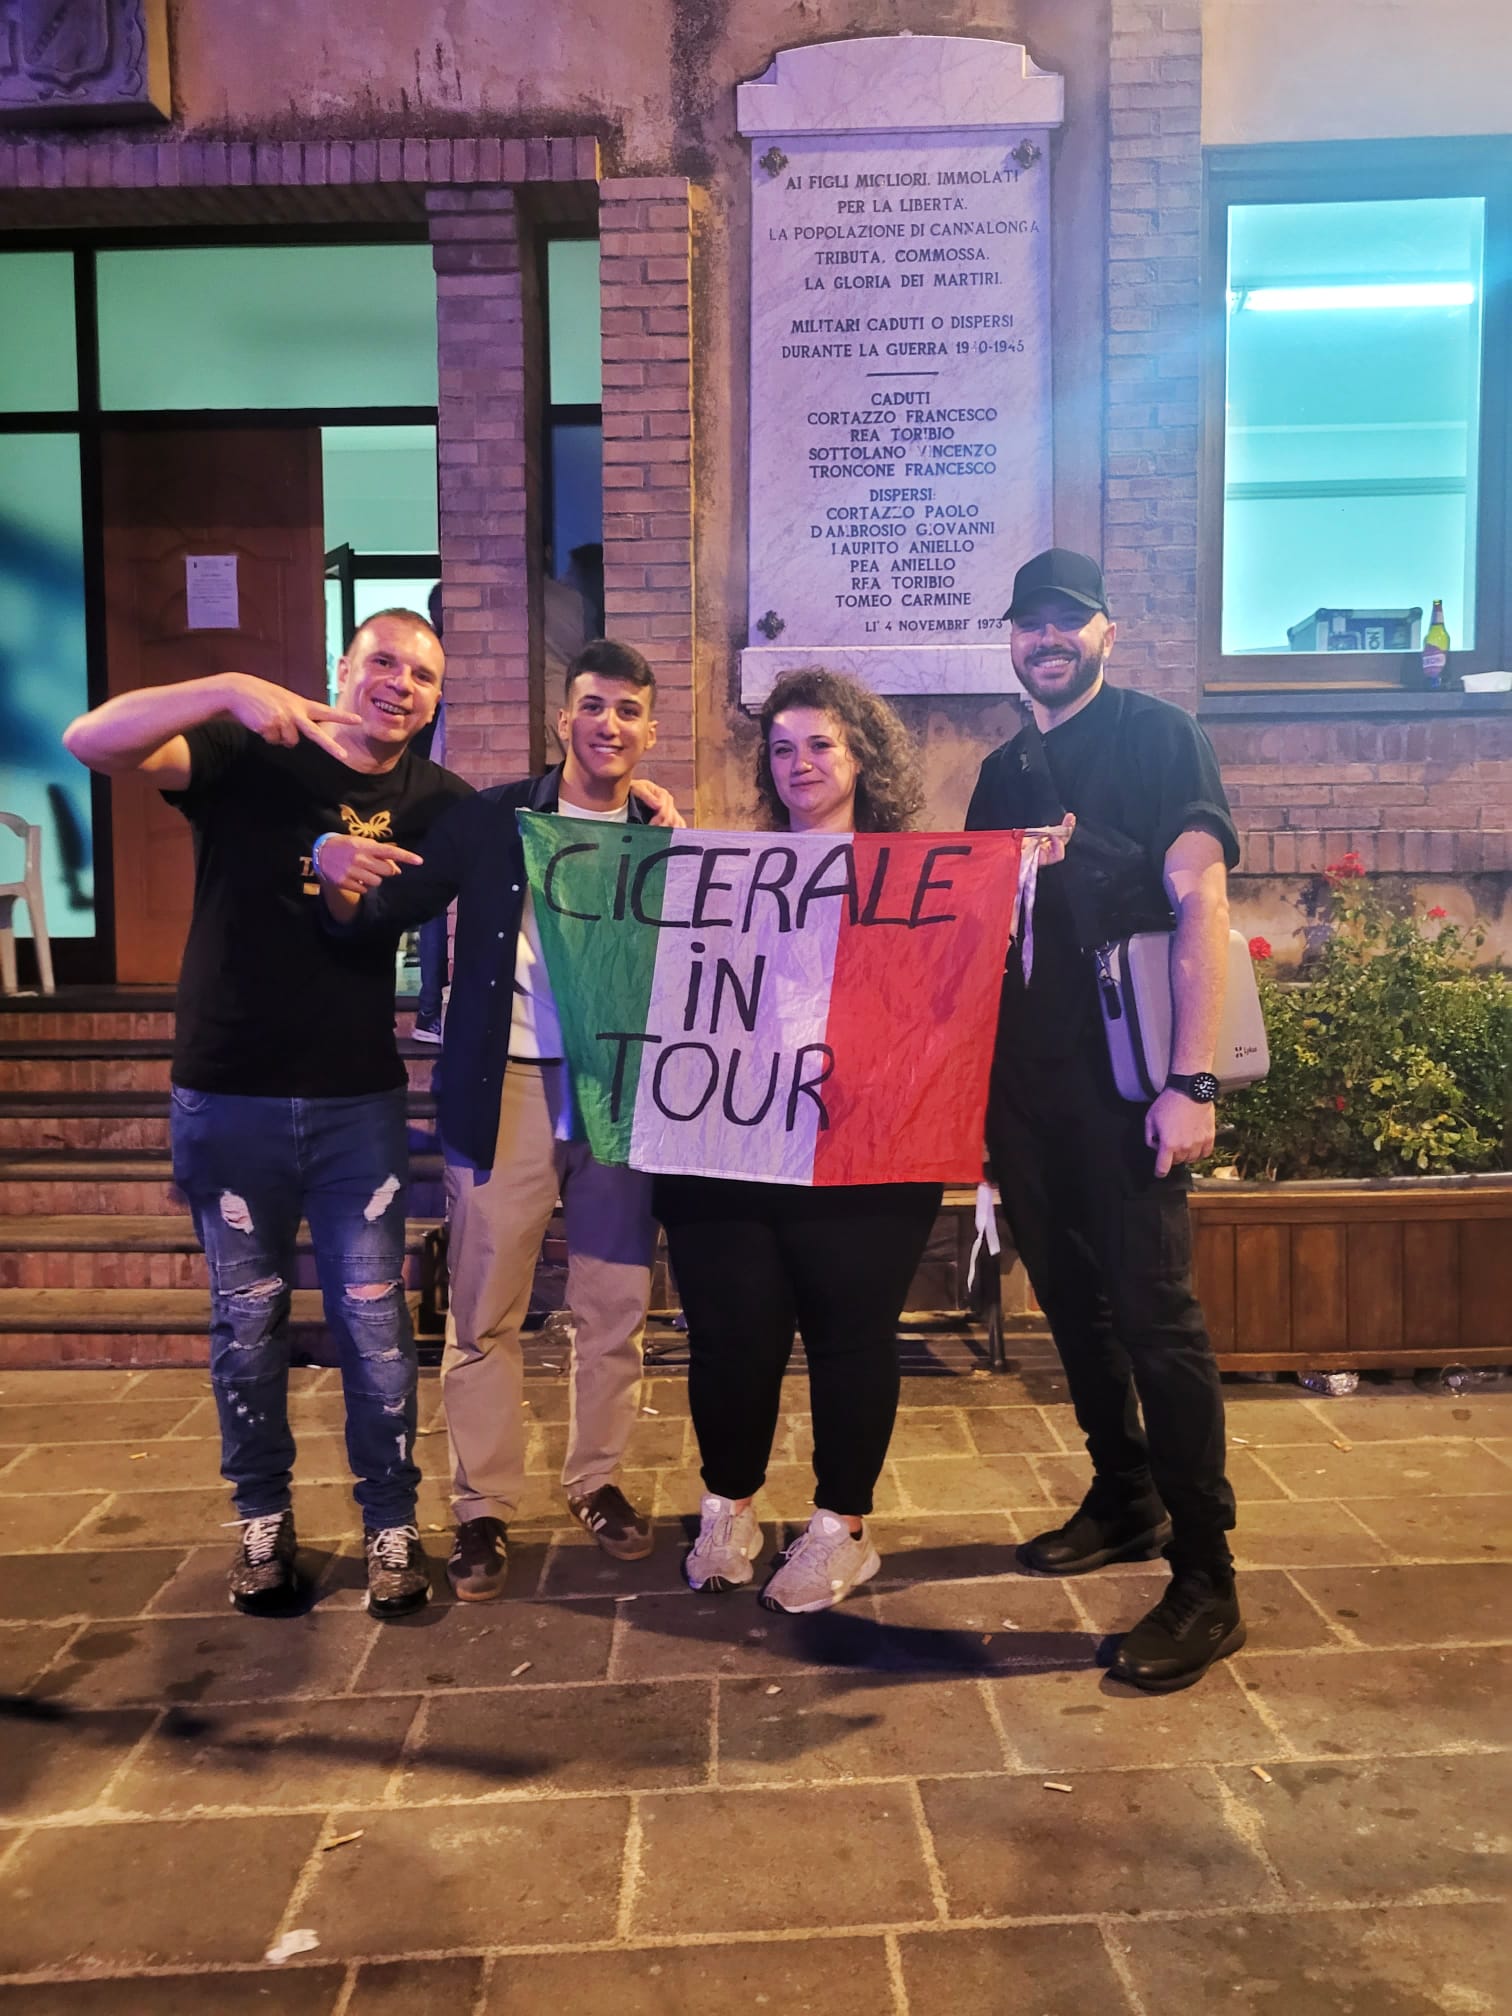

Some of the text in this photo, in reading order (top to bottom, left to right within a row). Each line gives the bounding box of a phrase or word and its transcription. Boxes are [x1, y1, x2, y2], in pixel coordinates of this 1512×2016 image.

[786, 175, 802, 190] AI
[809, 174, 849, 189] FIGLI
[937, 169, 1019, 186] IMMOLATI
[837, 199, 865, 214] PER
[873, 199, 893, 213] LA
[769, 220, 1040, 241] LA POPOLAZIONE DI CANNALONGA
[805, 277, 825, 290] LA
[833, 275, 892, 289] GLORIA
[901, 274, 924, 288] DEI
[867, 316, 924, 331] CADUTI
[931, 316, 944, 330] O
[951, 314, 1014, 329] DISPERSI
[782, 340, 1025, 359] DURANTE LA GUERRA 190-1945
[871, 392, 931, 406] CADUTI
[807, 408, 998, 425] CORTAZZO FRANCESCO
[850, 429, 880, 442] REA
[808, 446, 906, 461] SOTTOLANO
[809, 462, 997, 479] TRONCONE FRANCESCO
[925, 504, 979, 518] PAOLO
[908, 539, 974, 554] ANIELLO
[890, 557, 956, 572] ANIELLO
[891, 575, 955, 590] TORIBIO
[835, 592, 972, 608] TOMEO CARMINE
[885, 621, 893, 632] 4
[977, 618, 1003, 630] 1973
[596, 1032, 835, 1132] TOUR
